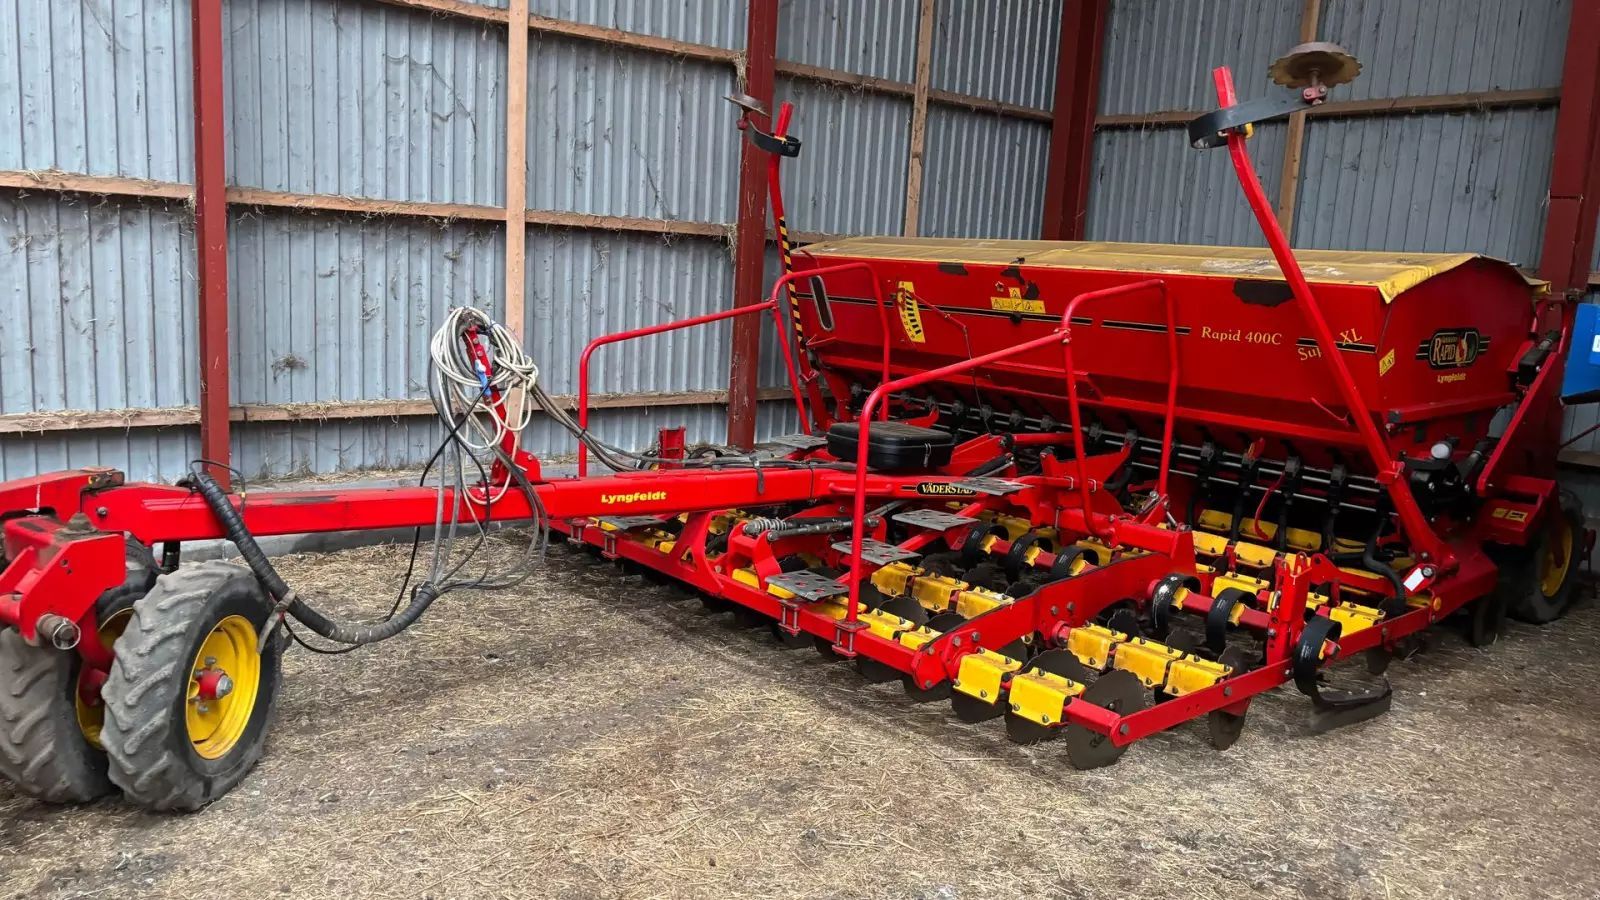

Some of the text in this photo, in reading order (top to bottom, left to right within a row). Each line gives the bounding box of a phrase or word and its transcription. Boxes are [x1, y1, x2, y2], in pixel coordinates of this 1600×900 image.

[1201, 326, 1283, 345] Rapid 400C
[1340, 328, 1363, 346] XL
[1433, 338, 1457, 365] RAPID
[601, 491, 667, 504] Lyngfeldt
